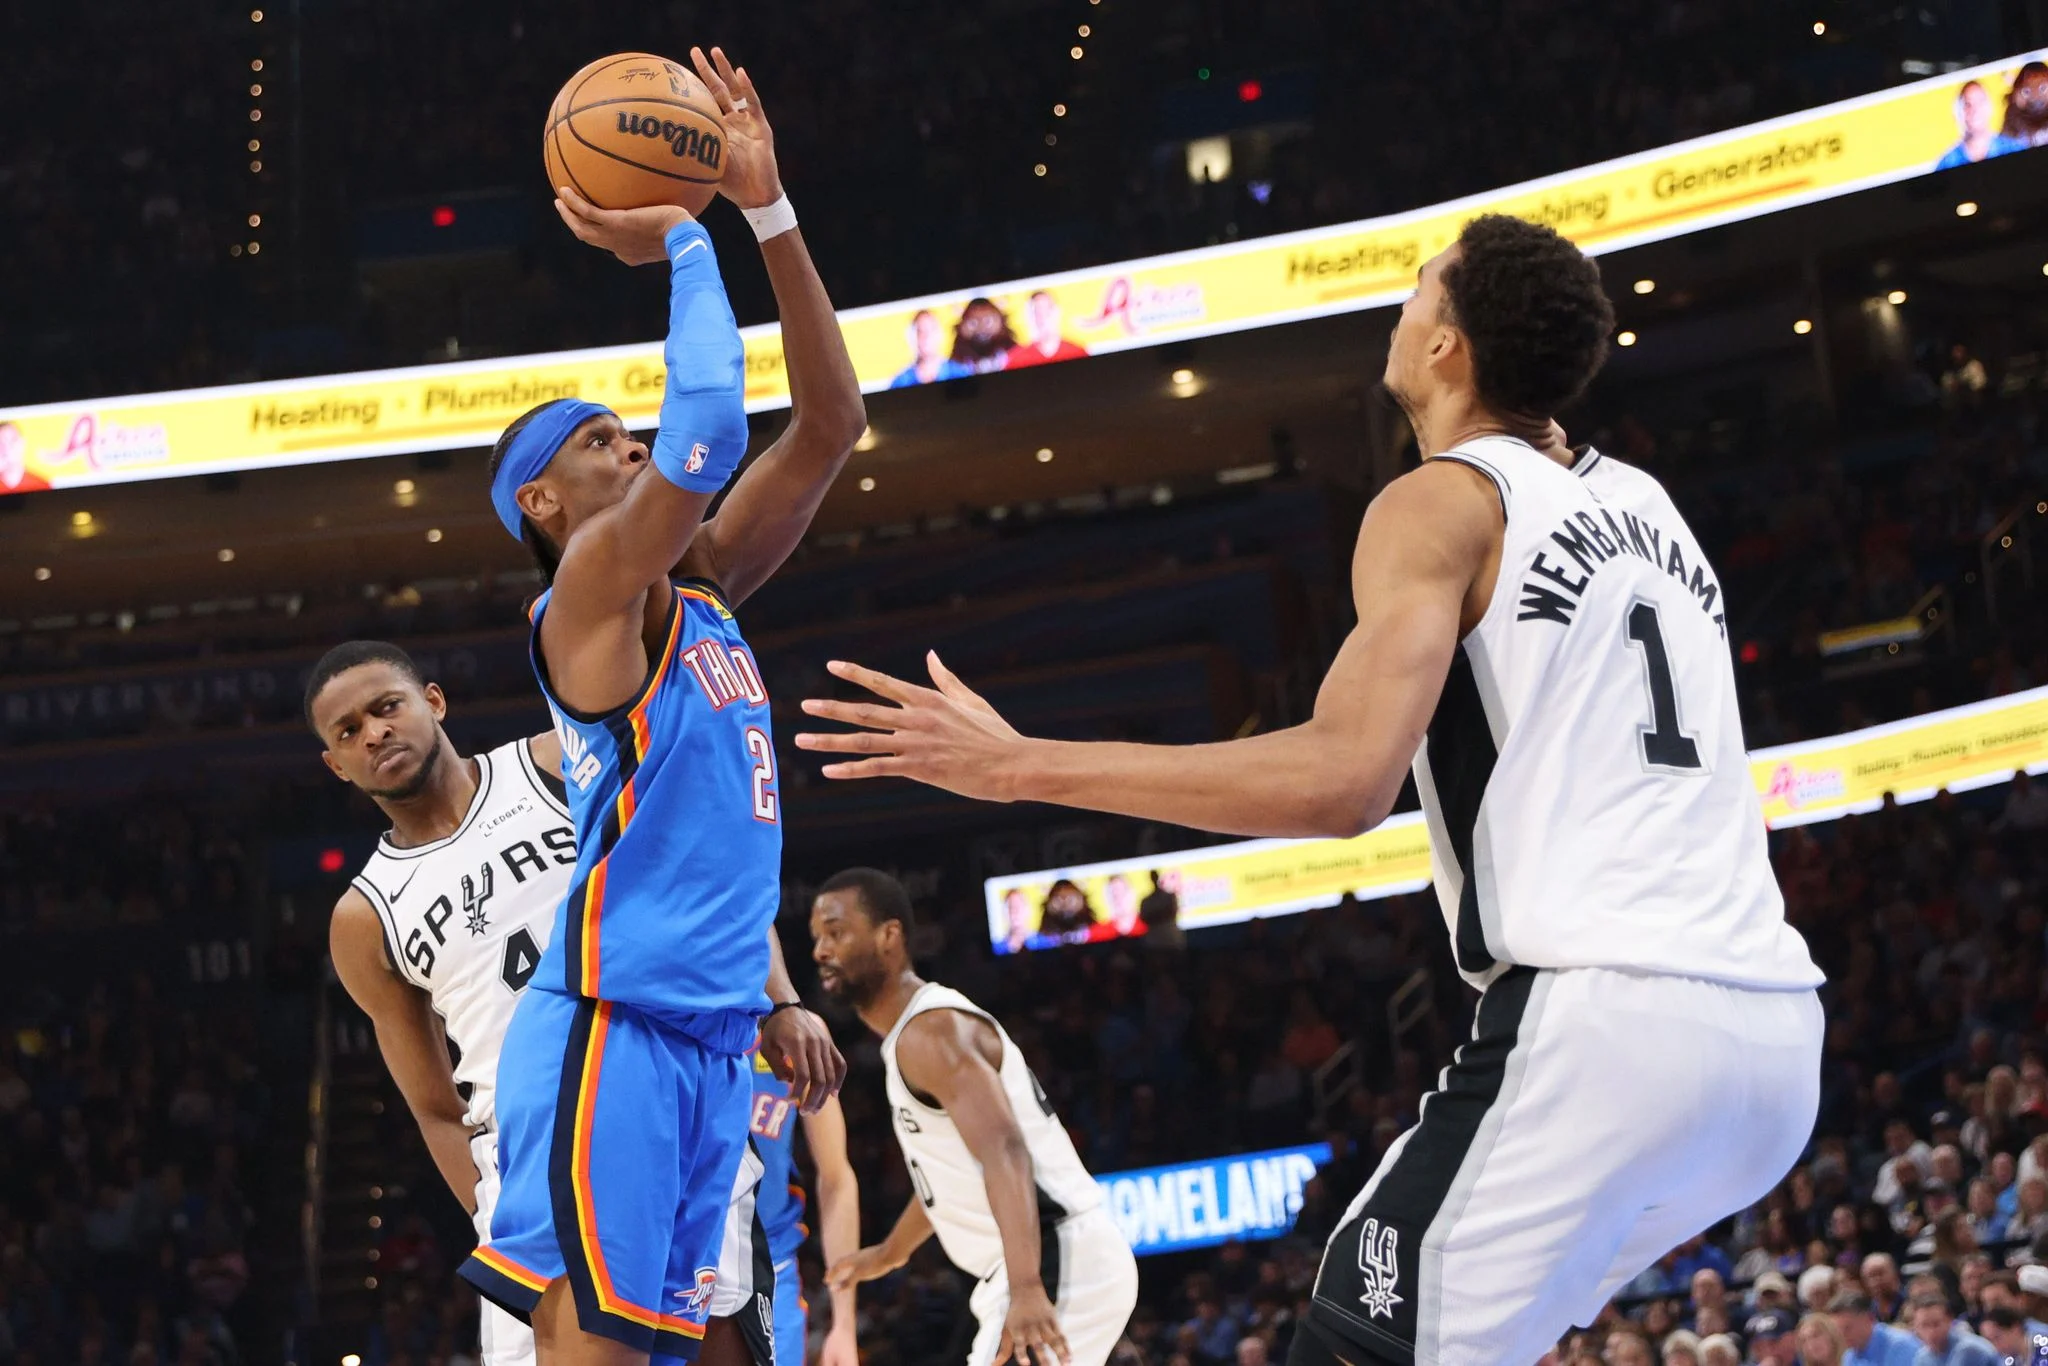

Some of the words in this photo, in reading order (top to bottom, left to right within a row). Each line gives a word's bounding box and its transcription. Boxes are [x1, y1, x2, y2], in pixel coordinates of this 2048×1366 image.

[616, 110, 721, 172] Wilson
[1286, 234, 1420, 283] Heating
[1653, 134, 1843, 200] Generators
[252, 396, 379, 432] Heating
[425, 373, 580, 415] Plumbing
[1626, 597, 1708, 773] 1
[486, 803, 526, 831] LEDGER
[404, 827, 578, 979] SPURS
[500, 924, 543, 995] 4
